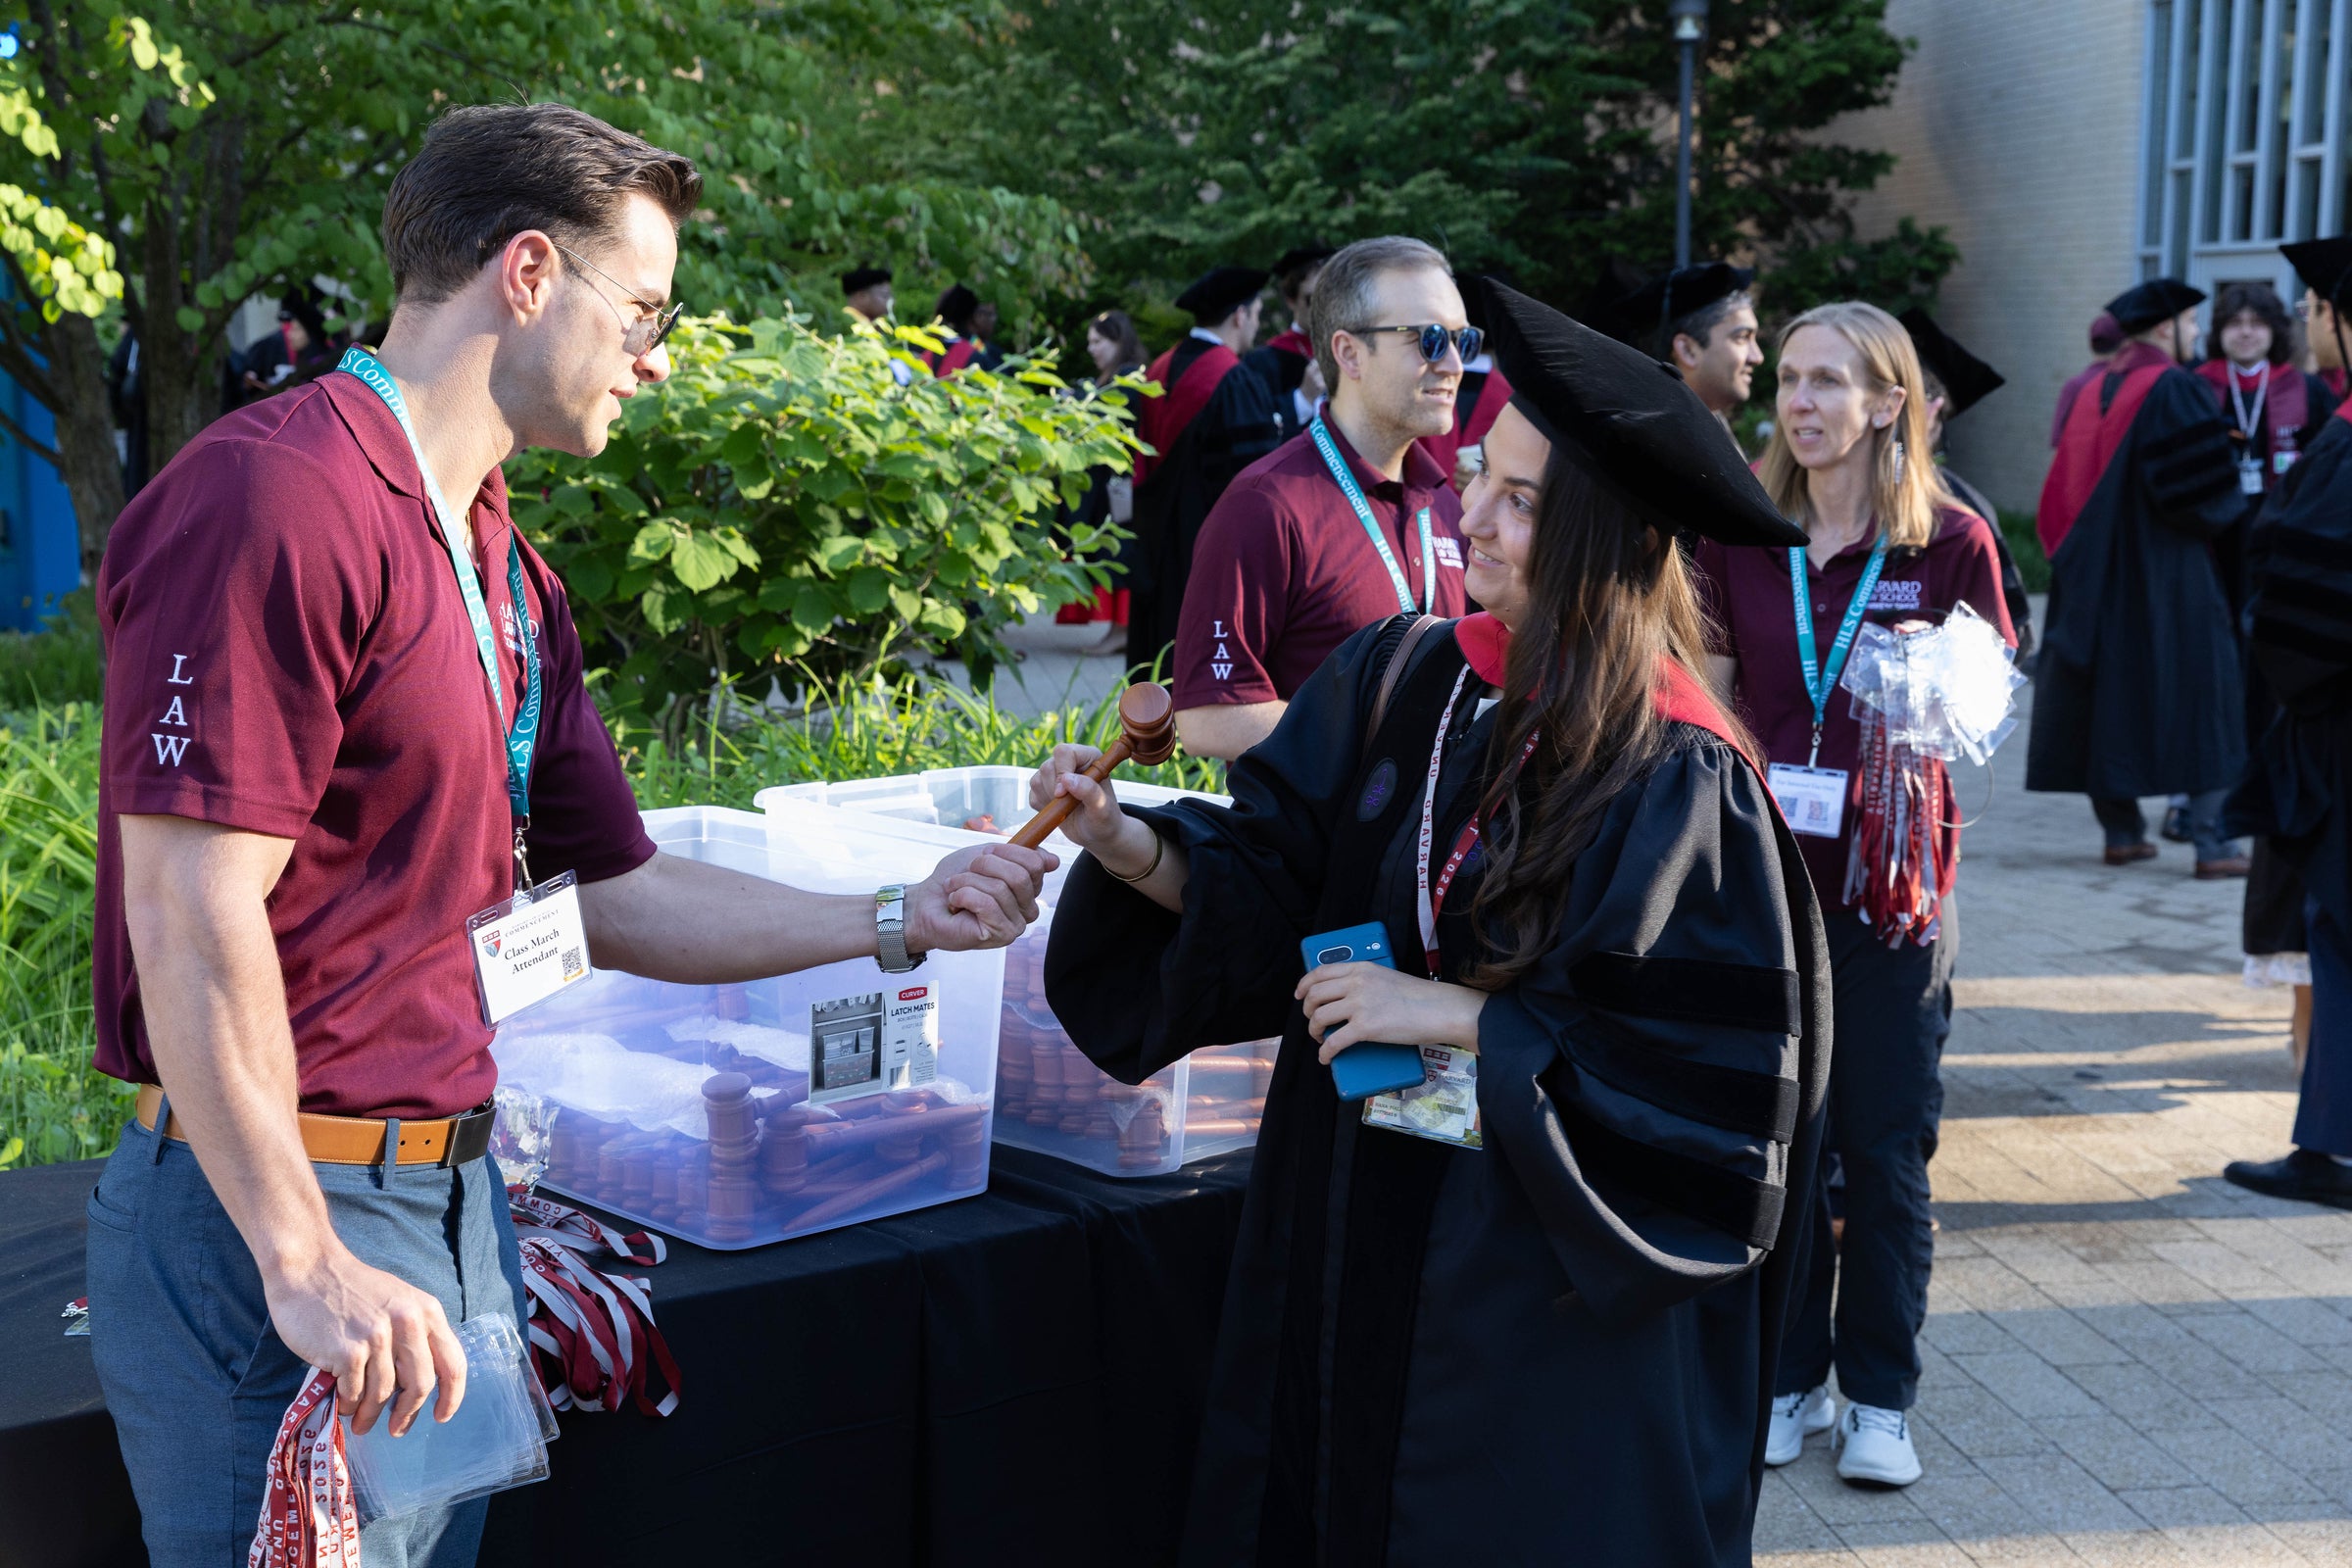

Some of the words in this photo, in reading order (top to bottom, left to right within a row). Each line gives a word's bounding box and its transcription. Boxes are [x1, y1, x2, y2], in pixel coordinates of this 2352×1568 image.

[1311, 422, 1369, 518] Commencement
[460, 573, 487, 628] HLS
[512, 567, 541, 734] Commencement
[1211, 620, 1234, 680] LAW
[1836, 609, 1860, 650] HLS
[151, 654, 194, 767] LAW
[1436, 851, 1463, 897] 2026
[504, 943, 529, 960] Class
[531, 928, 560, 950] March
[512, 946, 559, 974] Attendant
[891, 1006, 912, 1017] LATCH
[913, 1002, 935, 1013] MATES
[902, 989, 925, 999] CURVER
